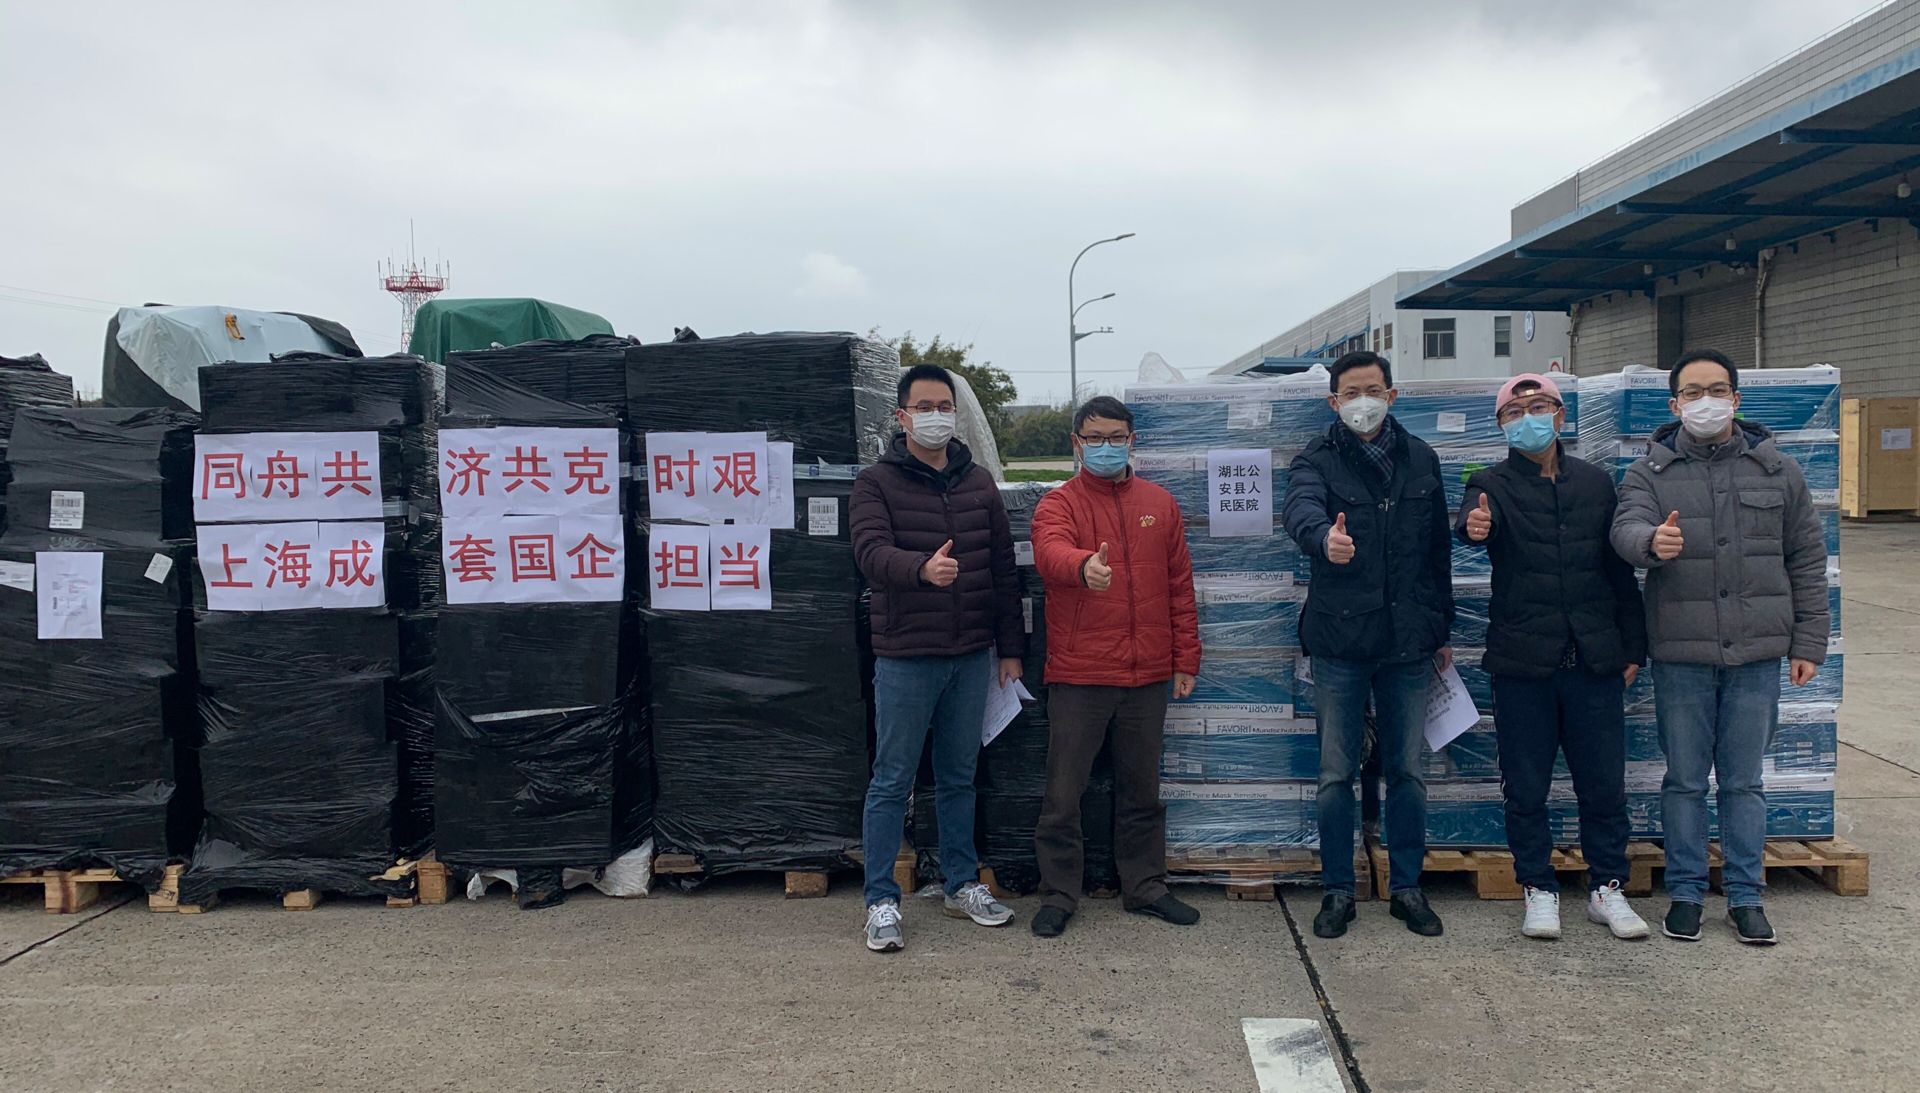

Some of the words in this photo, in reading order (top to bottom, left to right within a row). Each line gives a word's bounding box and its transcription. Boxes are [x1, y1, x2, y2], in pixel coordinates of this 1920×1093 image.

[1630, 377, 1657, 385] FAVORIT
[1773, 378, 1808, 386] Sensitive
[1283, 387, 1311, 395] FAVORIT
[1134, 393, 1169, 402] FAVORIT
[202, 450, 372, 500] 同舟共
[446, 446, 610, 496] 济共克
[654, 449, 760, 498] 时艰
[1218, 464, 1260, 478] 湖北公
[1219, 481, 1261, 495] 安县人
[1220, 498, 1259, 512] 民医院
[211, 539, 375, 588] 上海成
[449, 533, 616, 583] 套国企
[655, 541, 760, 590] 担当
[1248, 572, 1284, 580] FAVORIT
[1247, 704, 1284, 713] FAVORIT
[1217, 724, 1252, 733] FAVORIT
